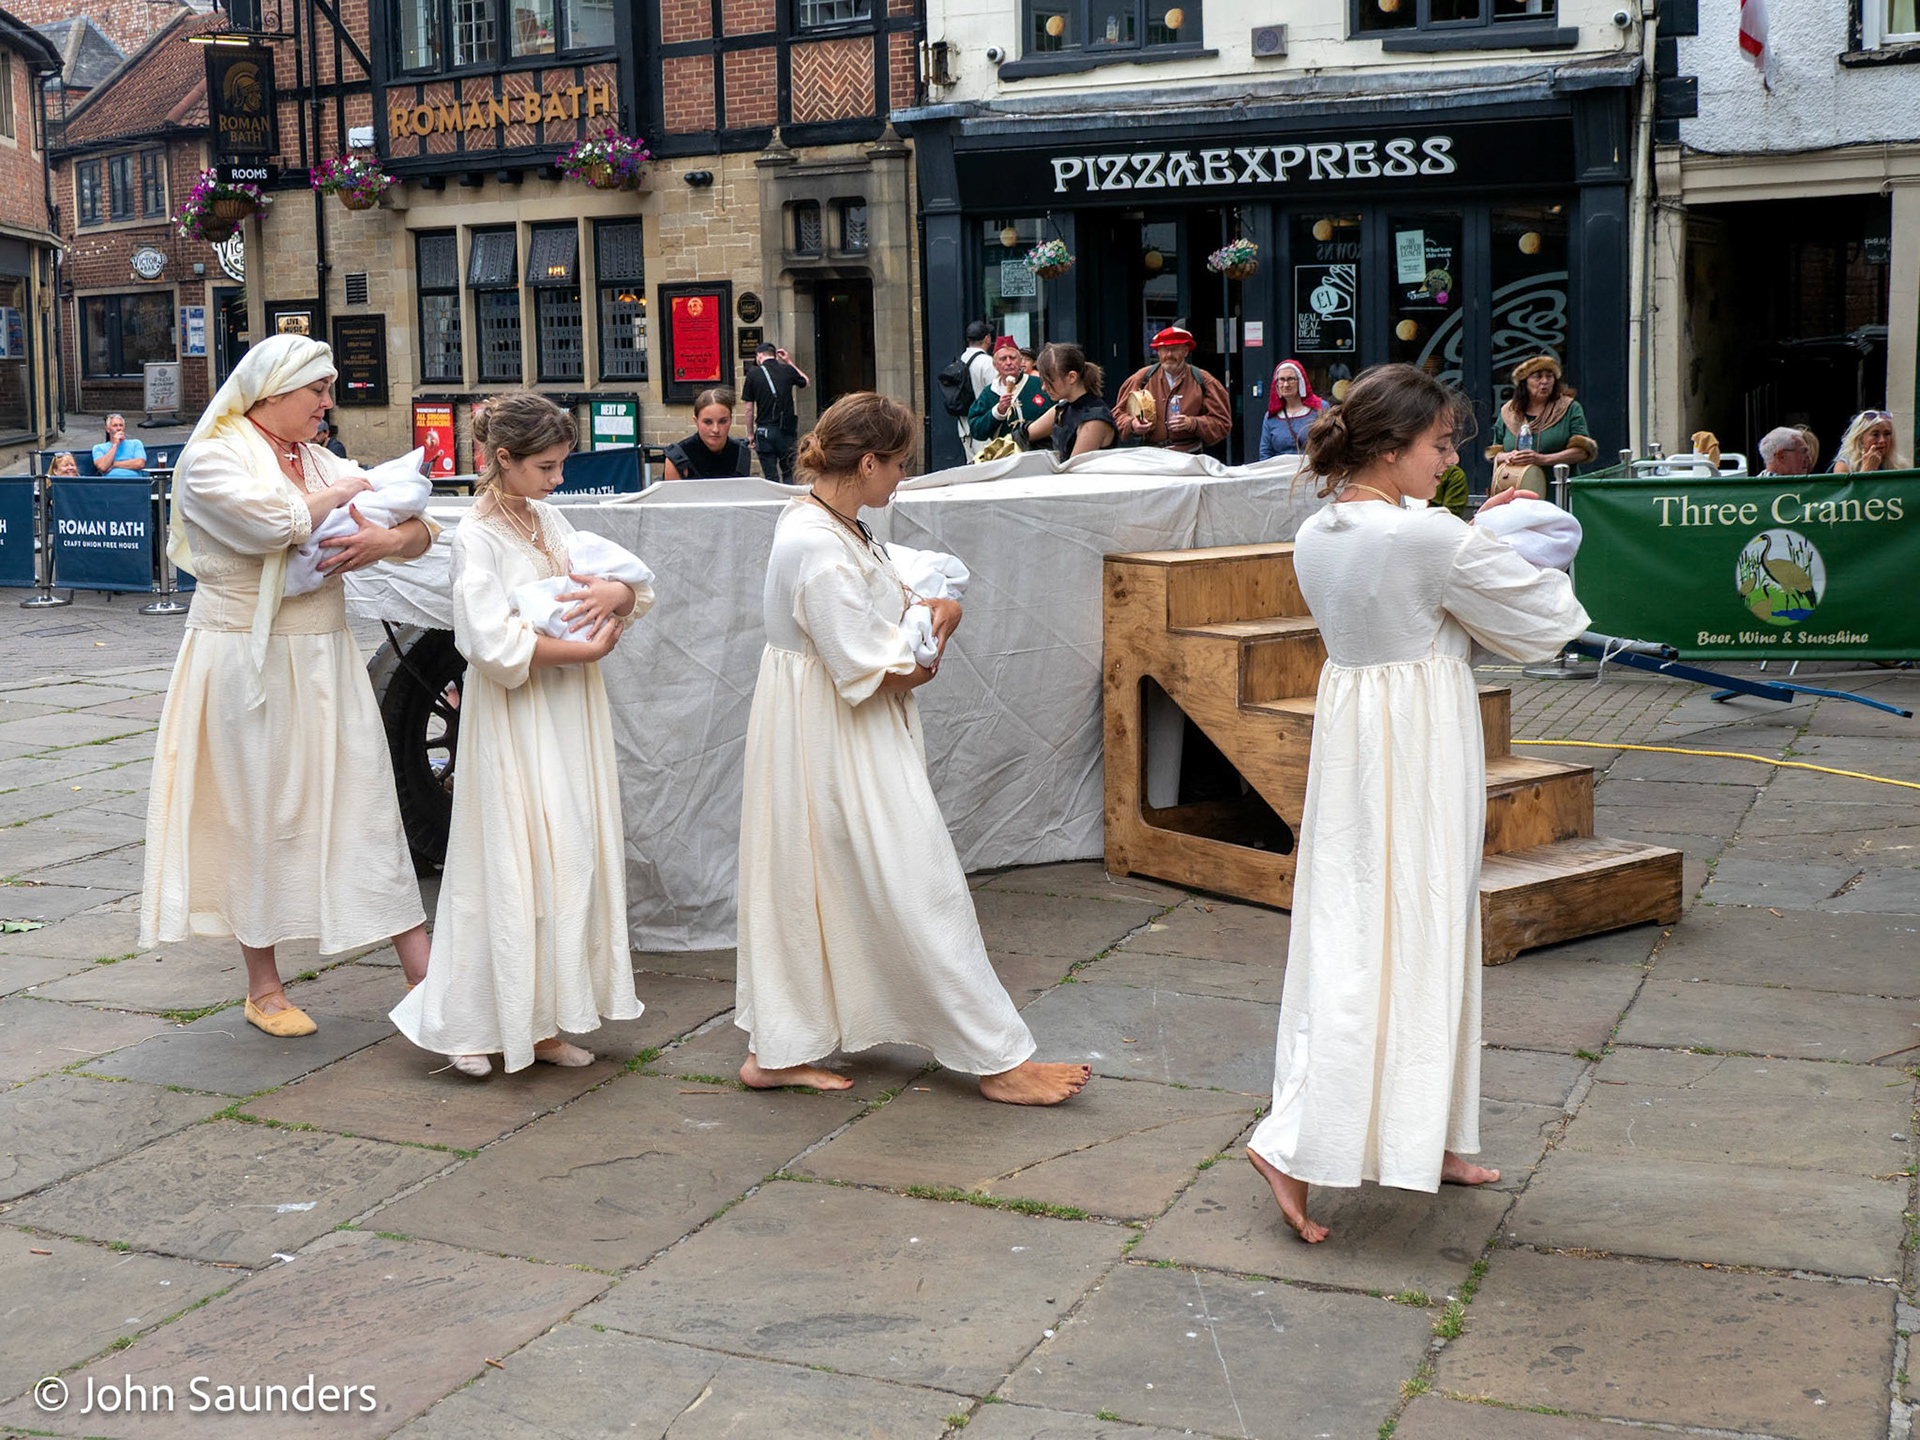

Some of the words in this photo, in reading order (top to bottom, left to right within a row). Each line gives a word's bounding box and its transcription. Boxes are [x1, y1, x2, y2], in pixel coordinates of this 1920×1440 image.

[390, 96, 510, 139] ROMAN
[524, 83, 610, 126] BATH
[219, 114, 270, 132] ROMAN
[230, 131, 262, 142] BATH
[231, 168, 268, 179] ROOMS
[1317, 290, 1332, 308] £1
[283, 326, 303, 334] MUSIC
[601, 404, 616, 415] NEXT
[617, 404, 627, 416] UP
[1652, 495, 1758, 527] Three
[1771, 493, 1904, 525] Cranes
[58, 519, 107, 535] ROMAN
[110, 521, 145, 537] BATH
[103, 541, 117, 549] FREE
[1697, 630, 1735, 646] Beer,
[1739, 631, 1778, 644] Wine
[1782, 631, 1793, 644] &
[1797, 630, 1869, 645] Sunshine
